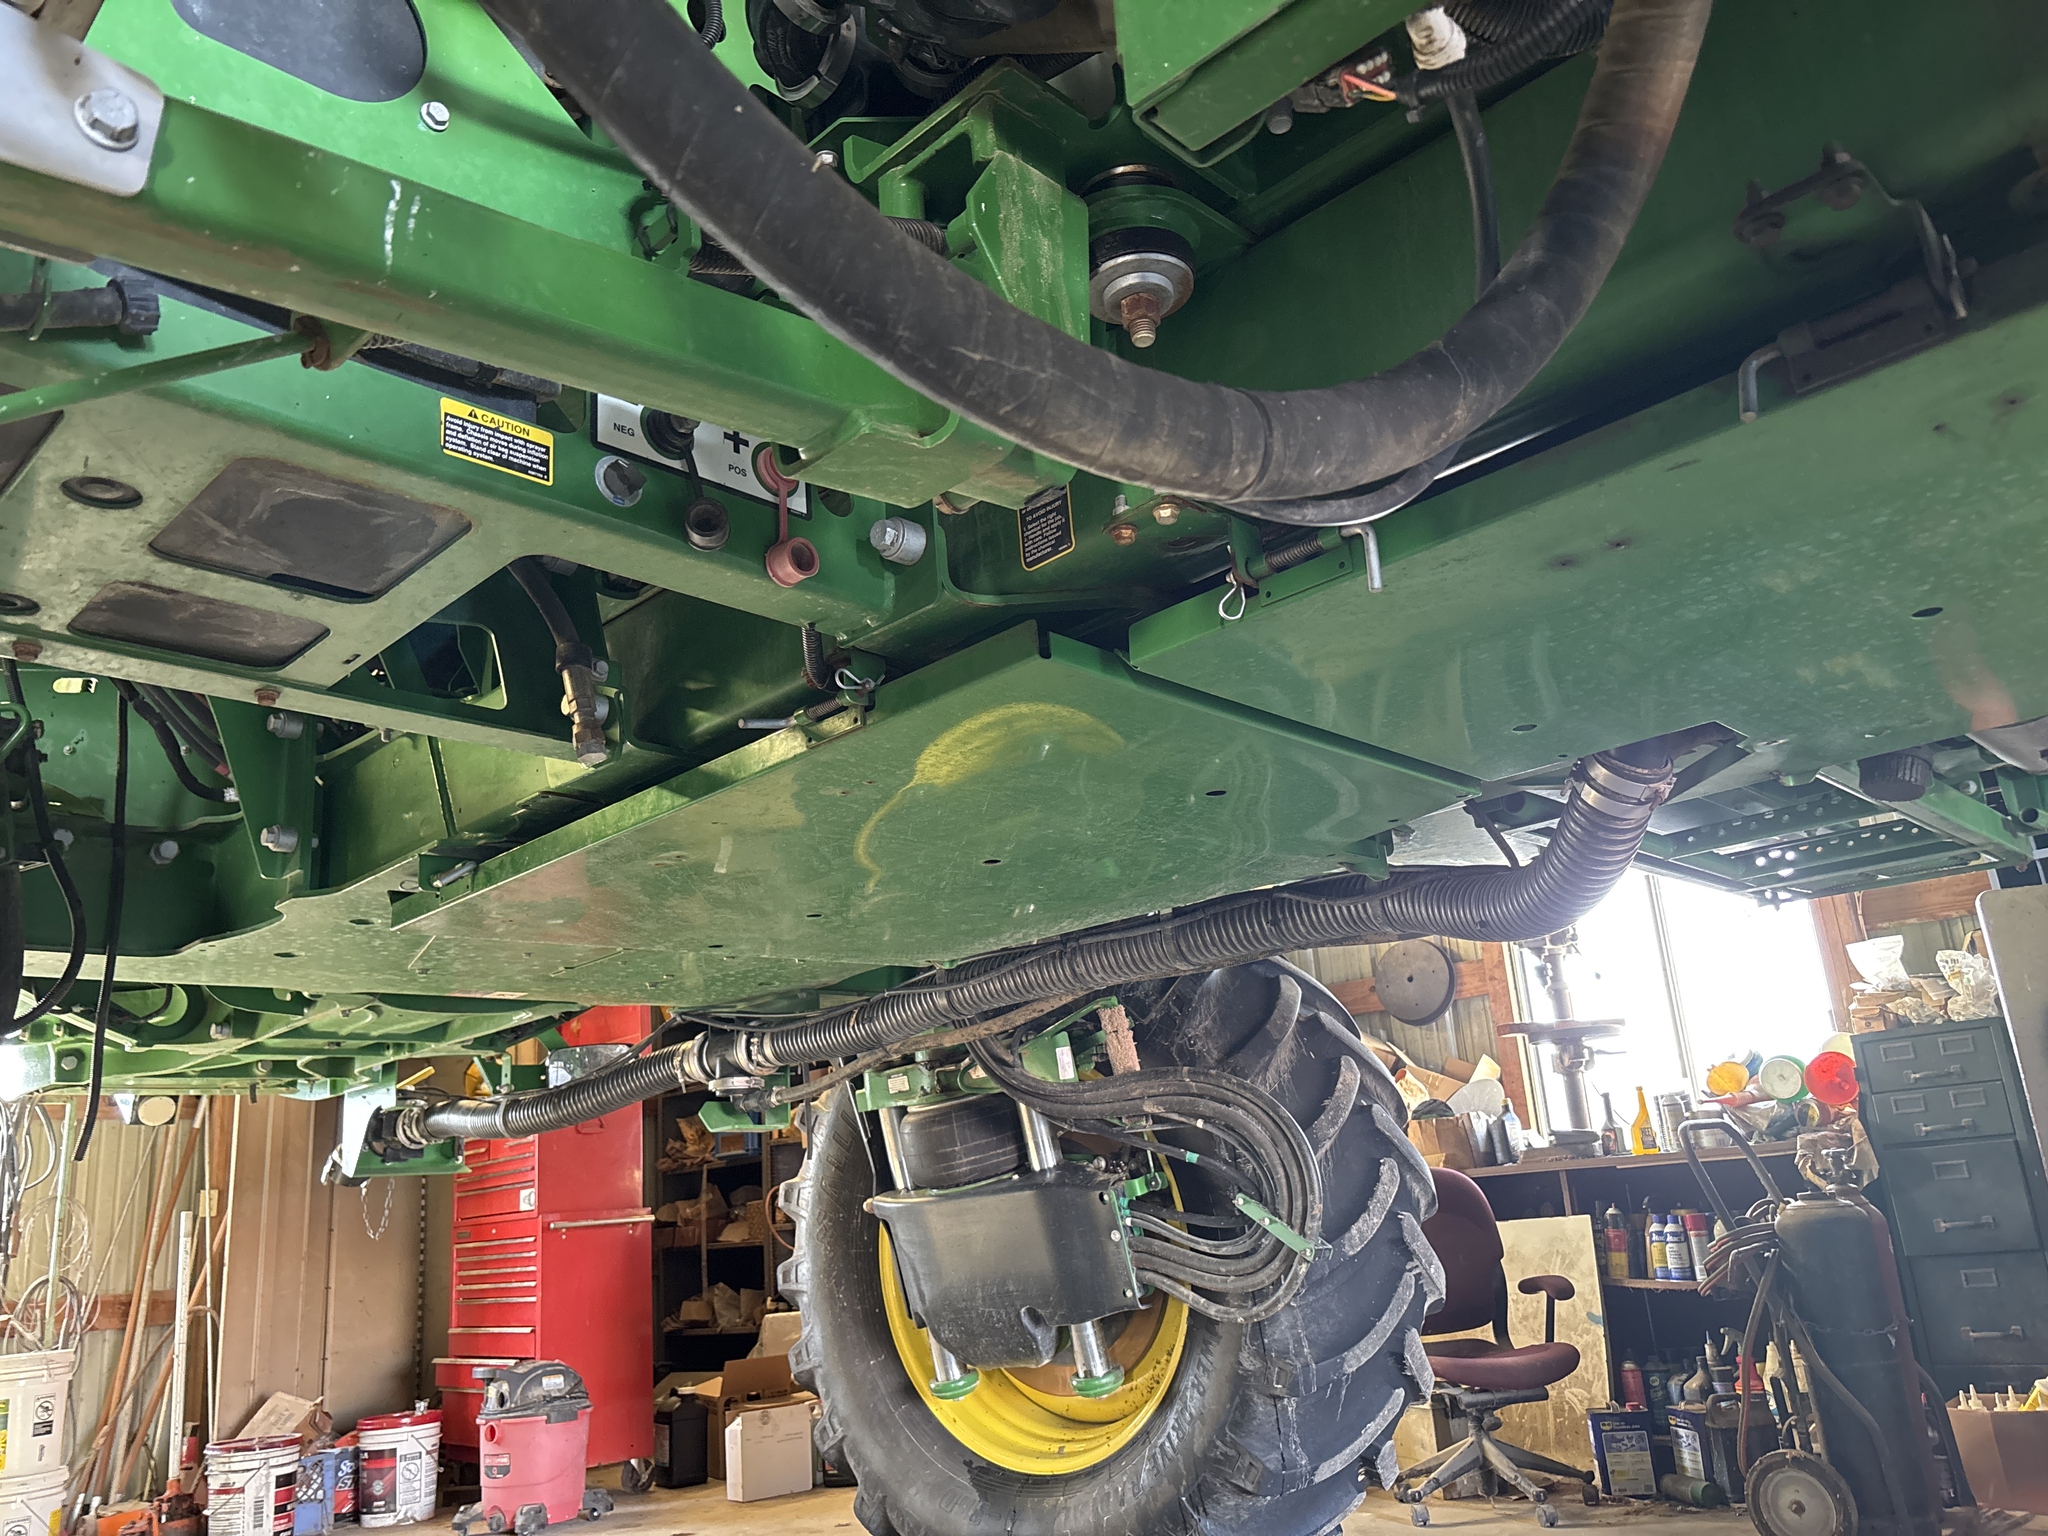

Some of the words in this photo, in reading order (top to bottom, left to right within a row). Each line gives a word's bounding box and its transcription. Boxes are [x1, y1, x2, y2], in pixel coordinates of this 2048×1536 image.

[446, 415, 463, 425] Avoid
[464, 419, 479, 431] injury
[481, 426, 493, 435] from
[495, 430, 513, 442] impact
[514, 437, 525, 446] with
[526, 442, 546, 453] sprayer
[481, 414, 530, 436] CAUTION
[613, 422, 635, 437] NEG
[445, 443, 472, 455] operating
[473, 451, 494, 462] system.
[445, 436, 467, 446] system.
[470, 443, 486, 453] Stand
[487, 448, 501, 457] clear
[509, 455, 531, 467] machine
[532, 463, 547, 471] when
[446, 429, 457, 437] and
[458, 432, 482, 445] deflation
[498, 446, 508, 454] bag
[510, 450, 540, 463] suspension
[466, 428, 488, 440] Chassis
[490, 438, 507, 447] moves
[508, 441, 526, 453] during
[527, 448, 548, 460] inflation
[728, 463, 747, 477] POS
[1033, 508, 1046, 518] AVOID
[1046, 500, 1062, 511] INJURY
[1044, 529, 1056, 537] Follow
[1051, 520, 1061, 529] apply
[1025, 538, 1048, 552] instructions
[1048, 530, 1061, 540] issued
[1038, 539, 1055, 551] chemical
